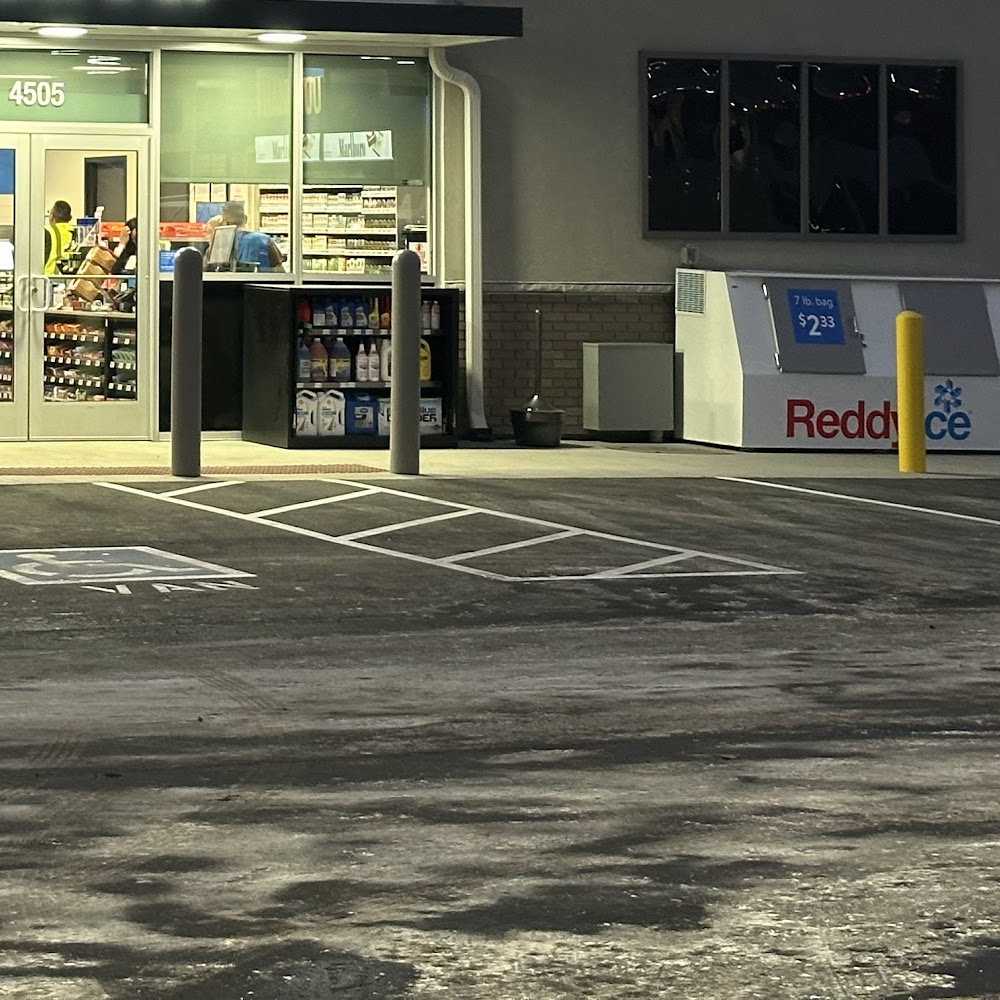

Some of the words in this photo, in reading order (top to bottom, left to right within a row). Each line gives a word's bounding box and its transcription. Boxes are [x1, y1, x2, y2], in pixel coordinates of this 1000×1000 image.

[8, 80, 65, 107] 4505
[794, 295, 800, 306] 7
[802, 296, 814, 306] lb.
[815, 297, 833, 310] bag
[925, 411, 971, 440] ce
